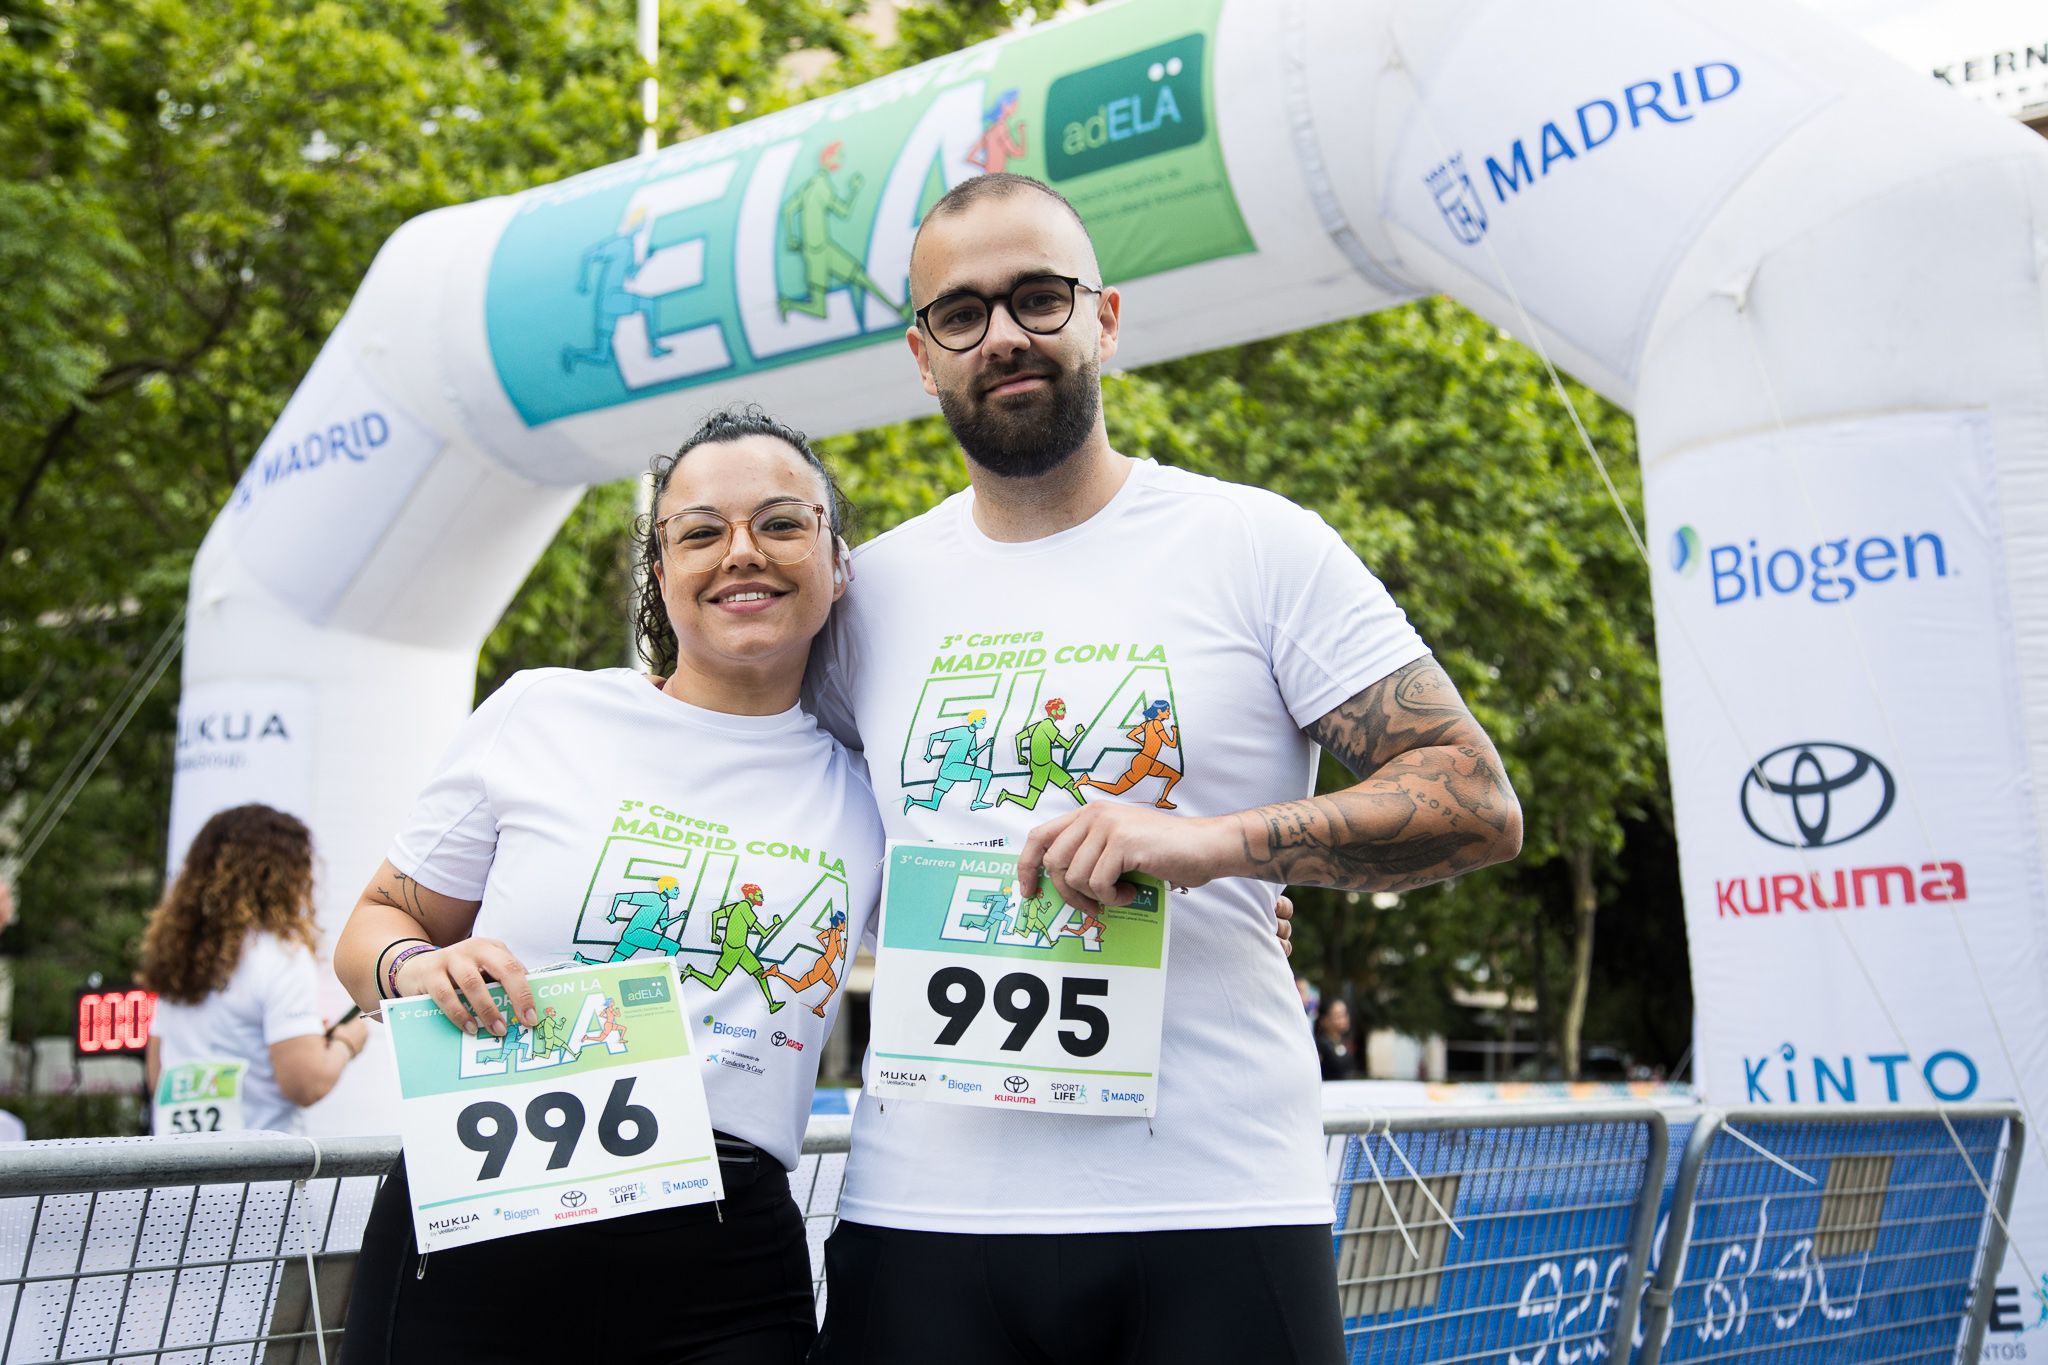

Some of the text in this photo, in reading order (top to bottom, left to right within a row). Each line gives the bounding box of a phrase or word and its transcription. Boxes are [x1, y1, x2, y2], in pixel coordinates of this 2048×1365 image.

[1485, 62, 1742, 203] MADRID
[264, 411, 390, 486] MADRID
[1710, 532, 1948, 606] Biogen
[966, 630, 1045, 648] Carrera
[930, 643, 1168, 674] MADRID CON LA
[901, 665, 1184, 787] ELA
[649, 804, 730, 835] Carrera
[611, 815, 847, 878] MADRID CON LA
[914, 855, 957, 869] Carrera
[960, 858, 1018, 876] MADRI
[572, 834, 849, 986] ELA
[939, 873, 1102, 953] ELA
[538, 978, 601, 998] CON LA
[927, 966, 1110, 1058] 995
[713, 1021, 757, 1040] Biogen
[880, 1070, 927, 1082] MUKUA
[948, 1079, 982, 1093] Biogen
[1050, 1082, 1080, 1092] SPORT
[1054, 1091, 1076, 1101] LIFE
[1111, 1092, 1145, 1104] MADRID
[172, 1106, 222, 1132] 532
[456, 1076, 659, 1182] 996
[608, 1182, 639, 1197] SPORT
[673, 1178, 709, 1192] MADRID
[614, 1192, 637, 1204] LIFE
[429, 1213, 480, 1230] MUKUA
[504, 1207, 540, 1221] Biogen
